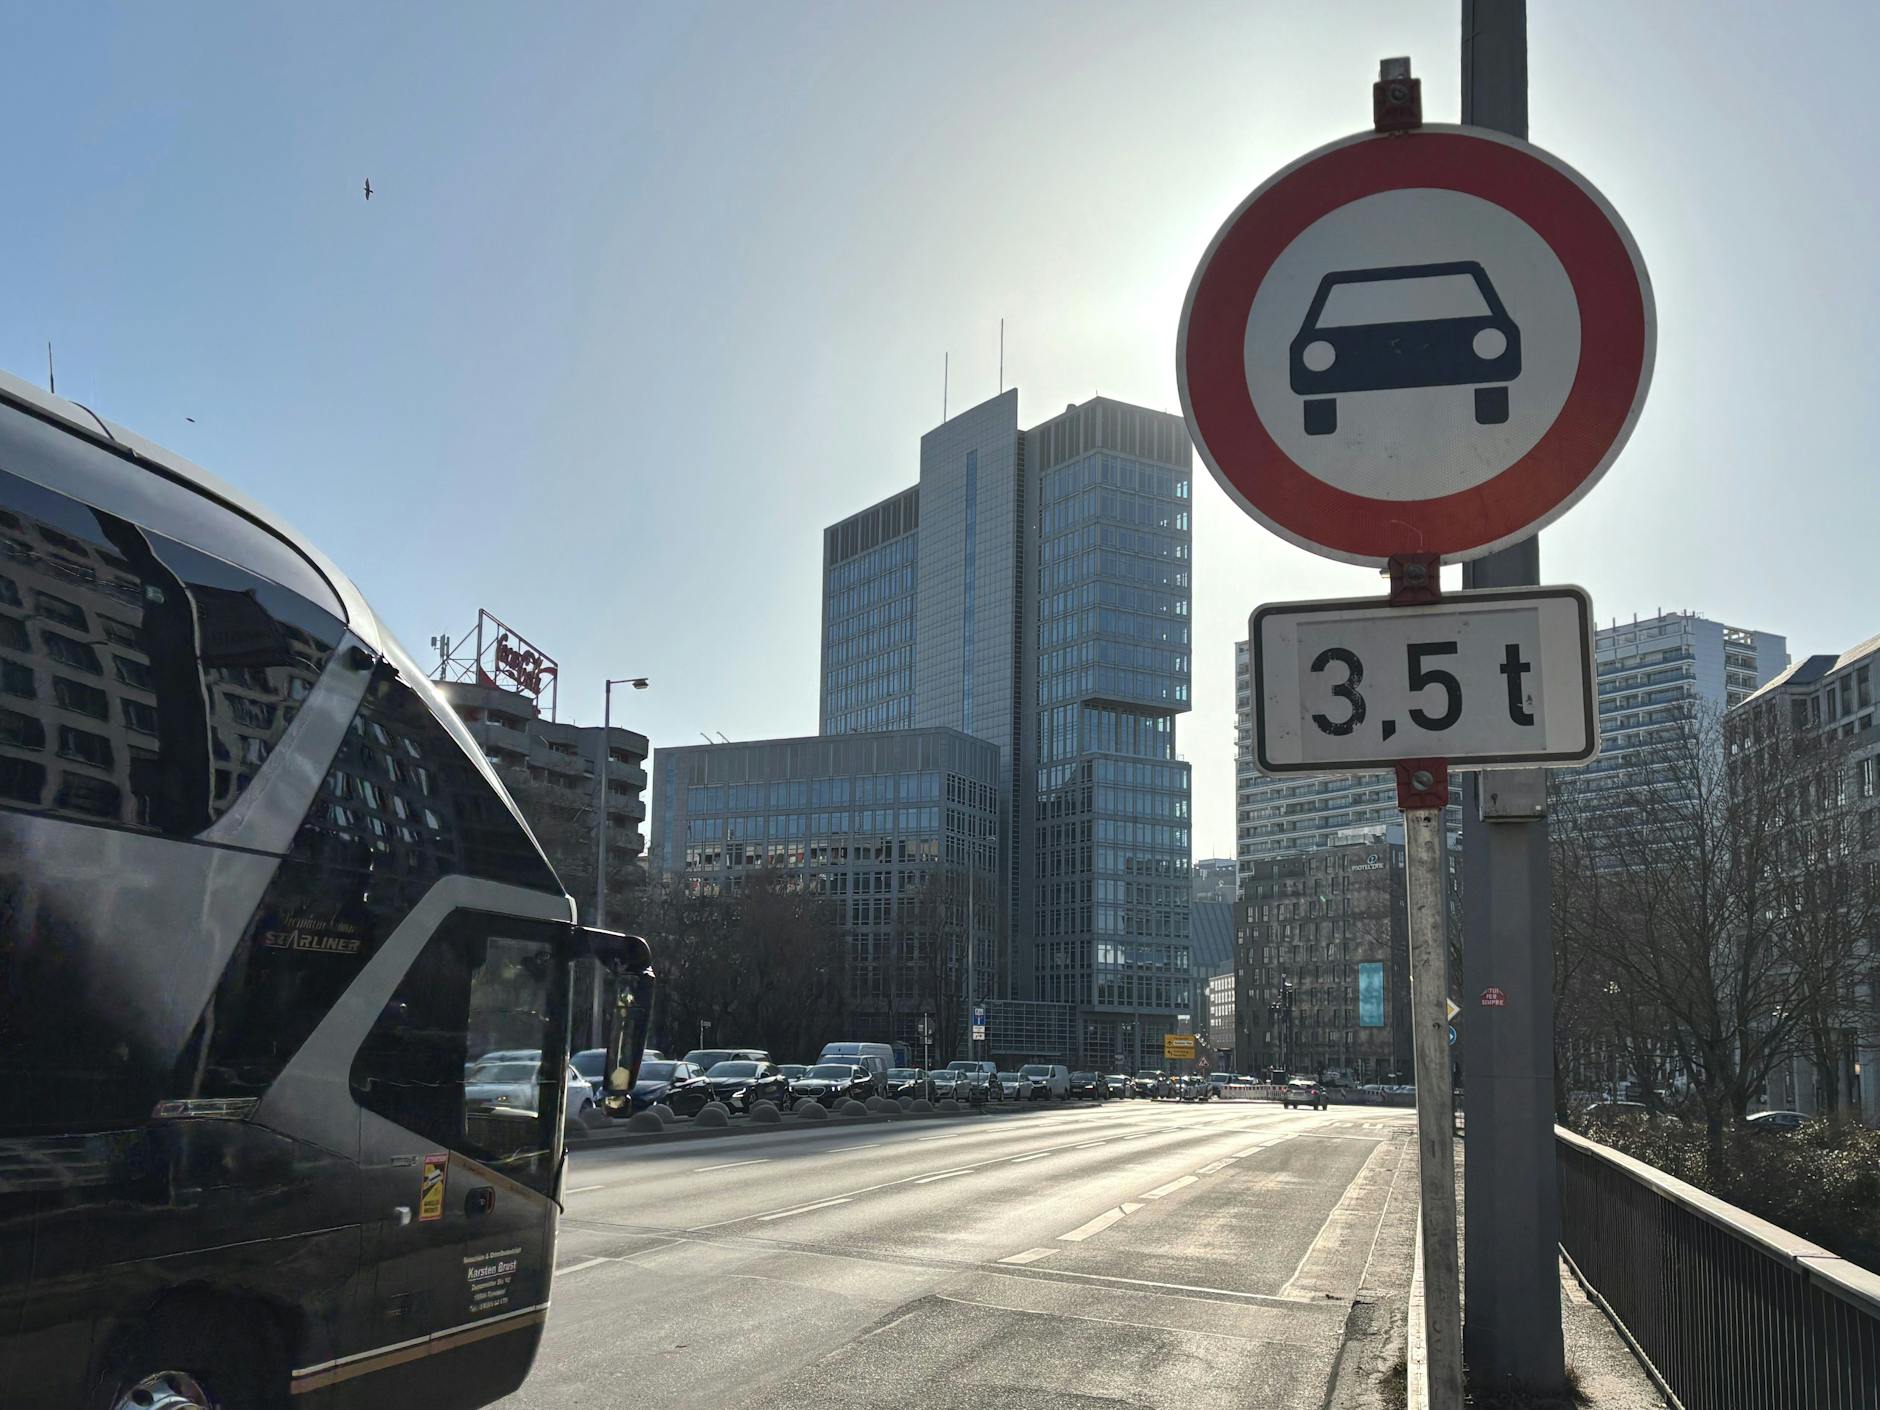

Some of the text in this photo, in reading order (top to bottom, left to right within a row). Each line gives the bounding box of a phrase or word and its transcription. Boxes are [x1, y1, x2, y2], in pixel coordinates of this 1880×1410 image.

[1310, 641, 1535, 743] 3,5 t
[264, 930, 361, 952] STARLINER
[467, 1259, 517, 1280] Karsten Brust
